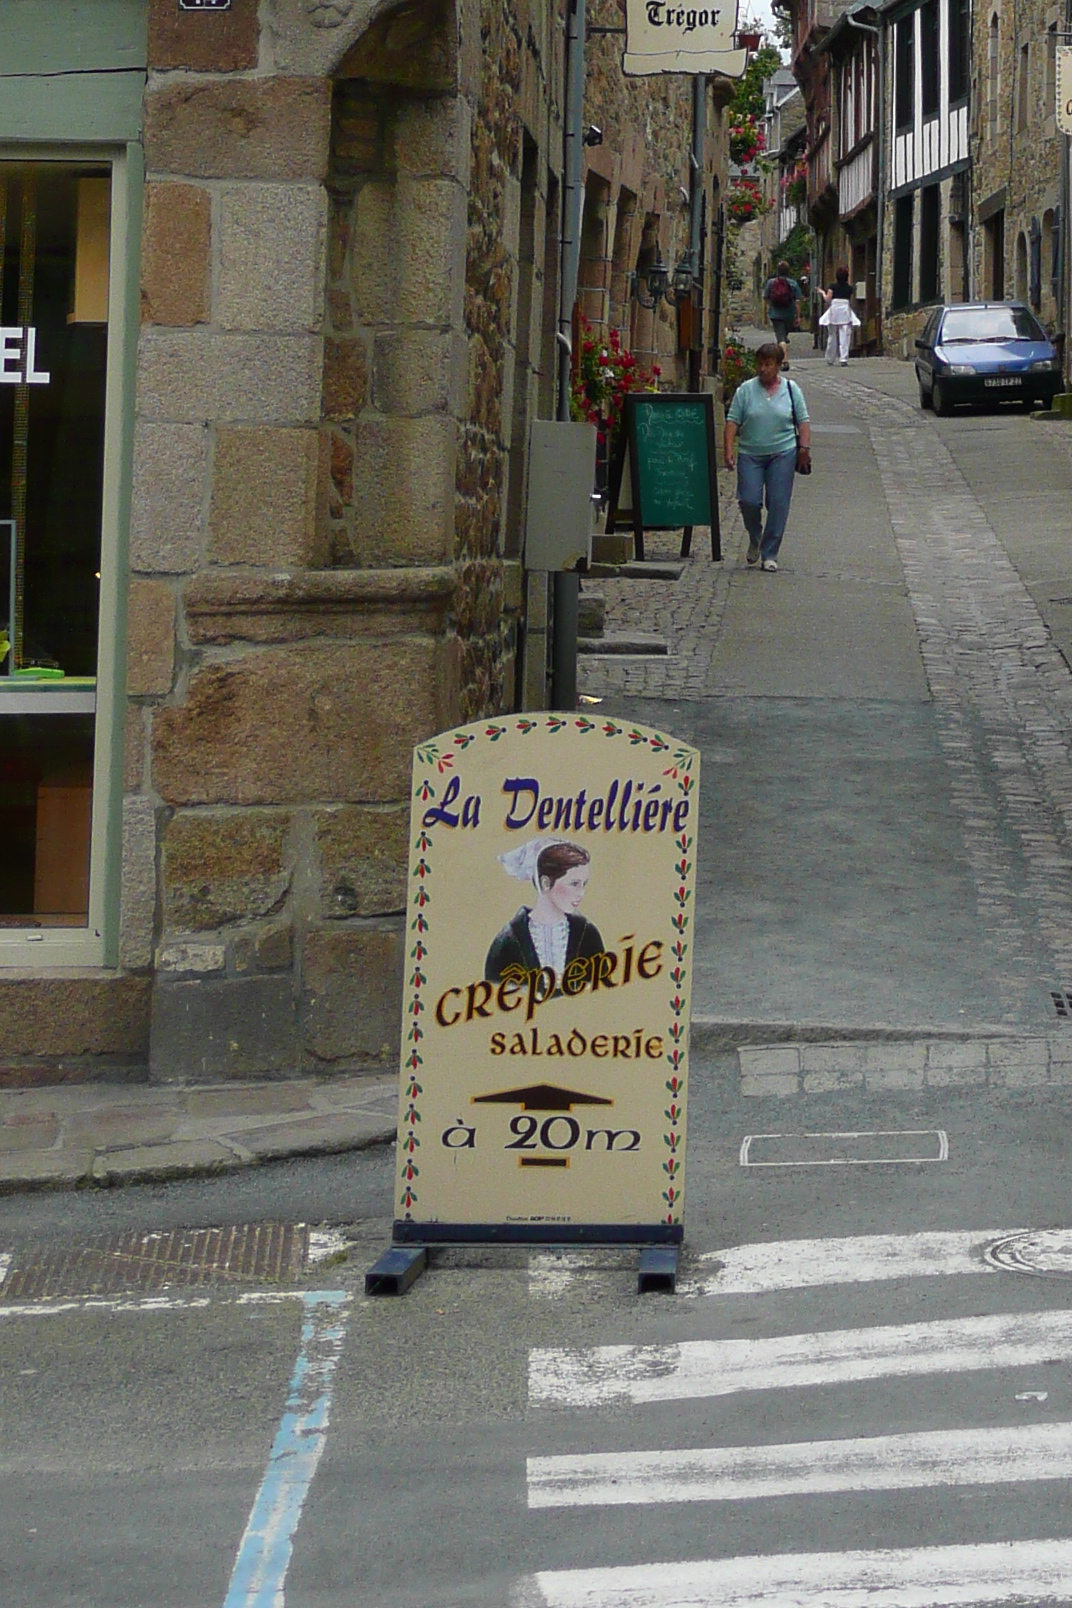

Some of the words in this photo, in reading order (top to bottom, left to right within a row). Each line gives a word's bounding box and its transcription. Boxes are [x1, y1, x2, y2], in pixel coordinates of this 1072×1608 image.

[645, 0, 721, 35] Trégor
[422, 775, 481, 829] La
[441, 1118, 476, 1149] à
